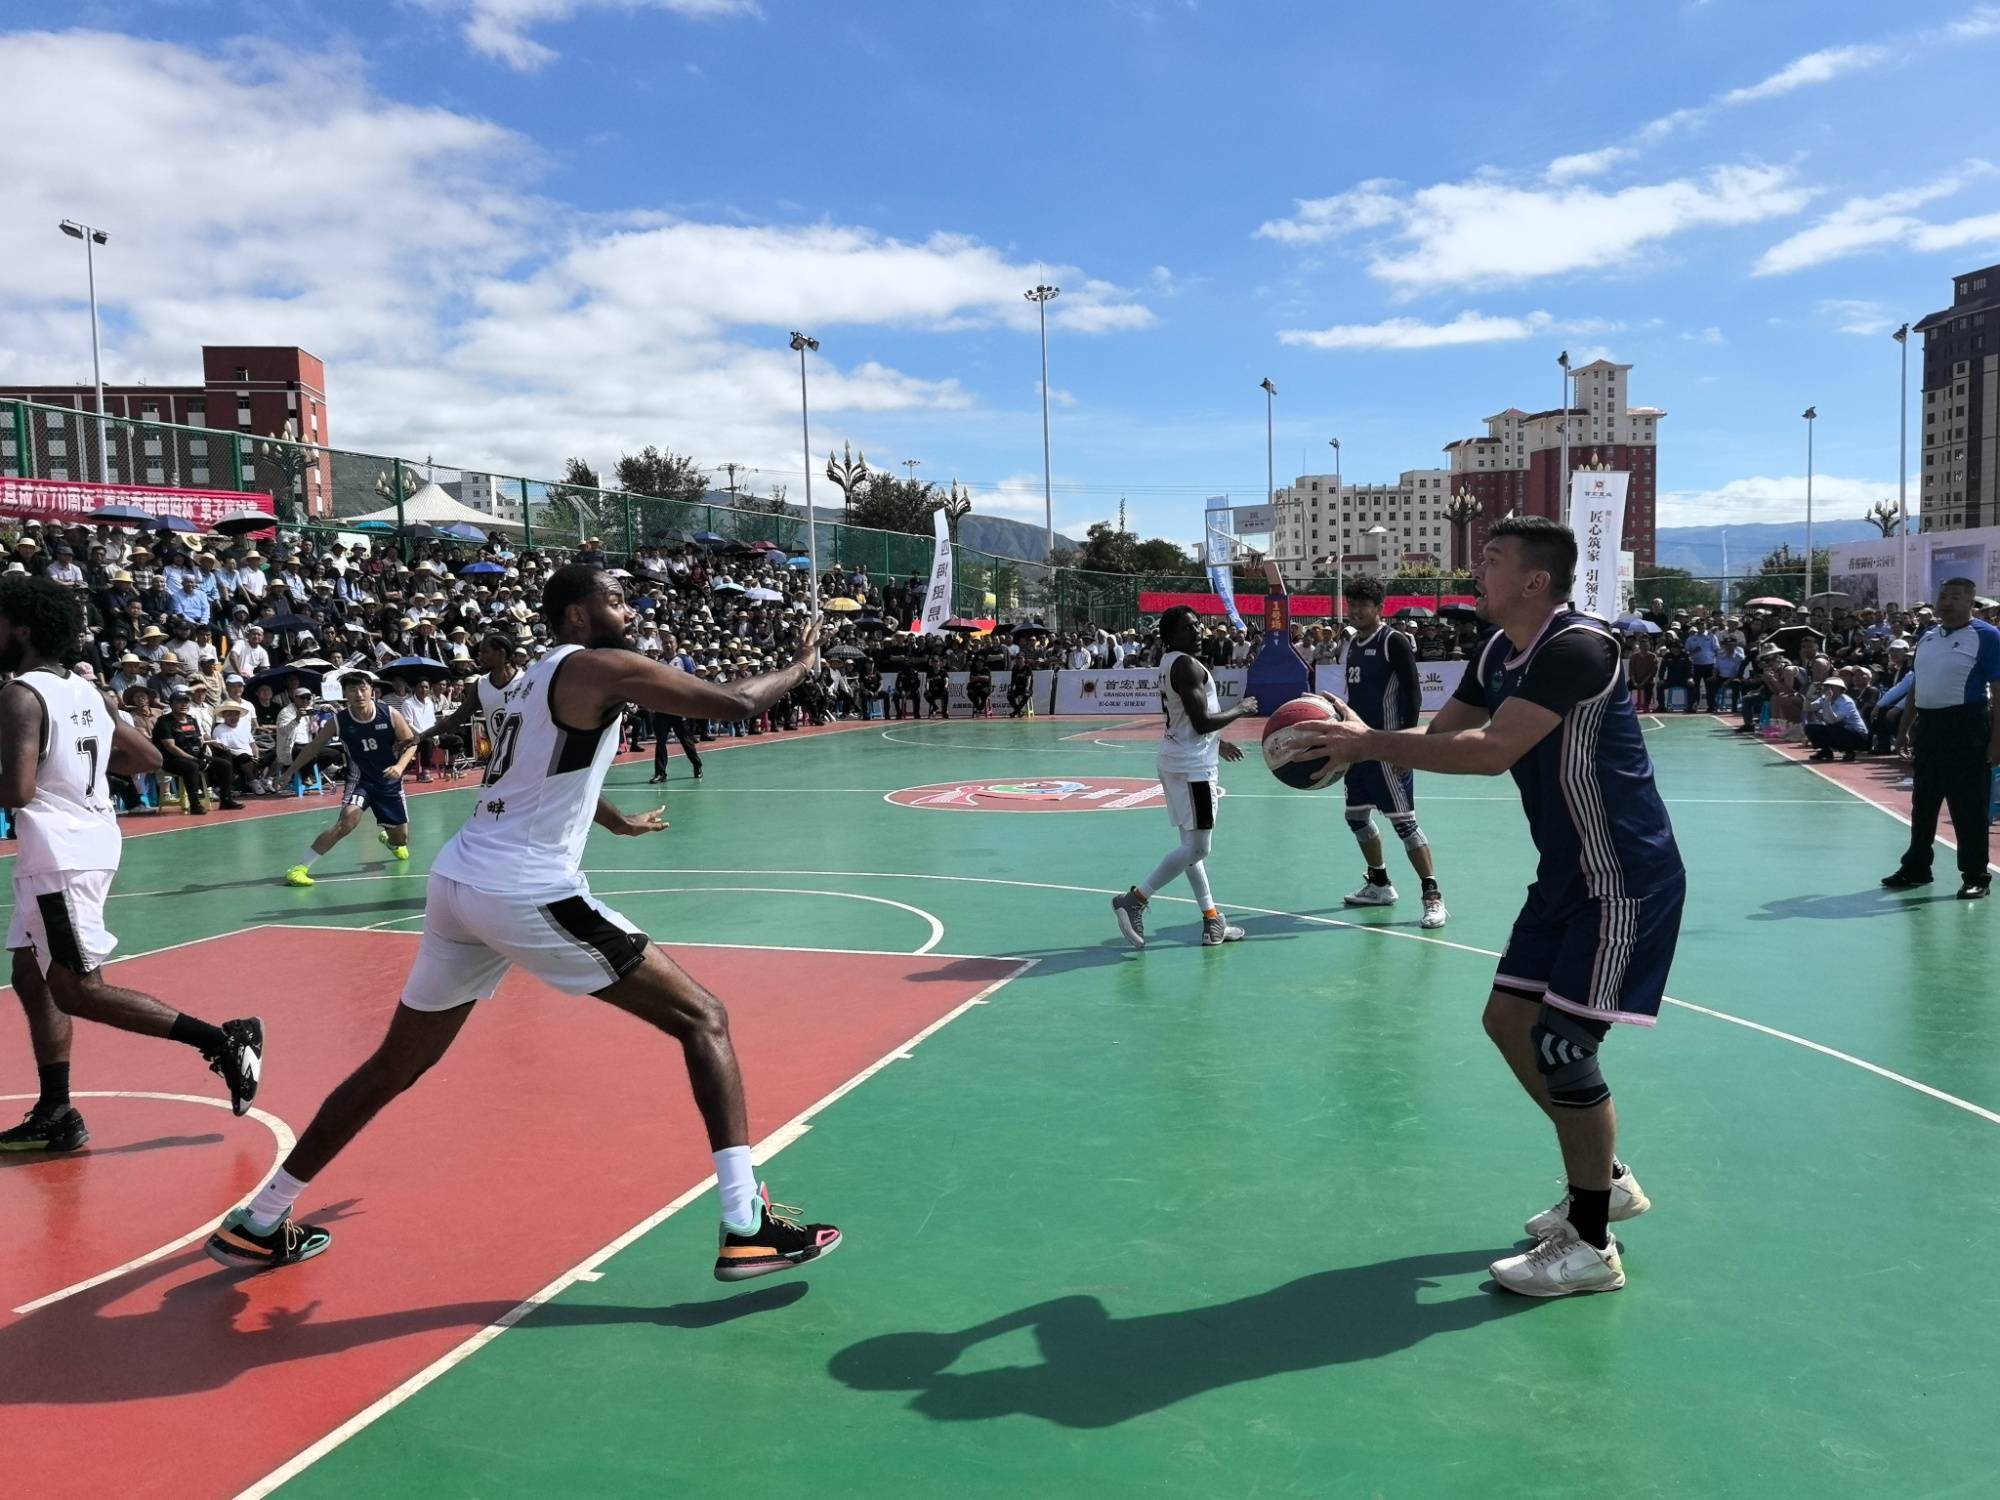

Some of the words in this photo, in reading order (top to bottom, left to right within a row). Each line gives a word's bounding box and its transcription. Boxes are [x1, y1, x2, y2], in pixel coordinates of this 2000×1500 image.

[1587, 510, 1603, 562] 匠心筑家
[1348, 666, 1361, 683] 23
[361, 738, 378, 751] 18
[75, 735, 99, 799] 7
